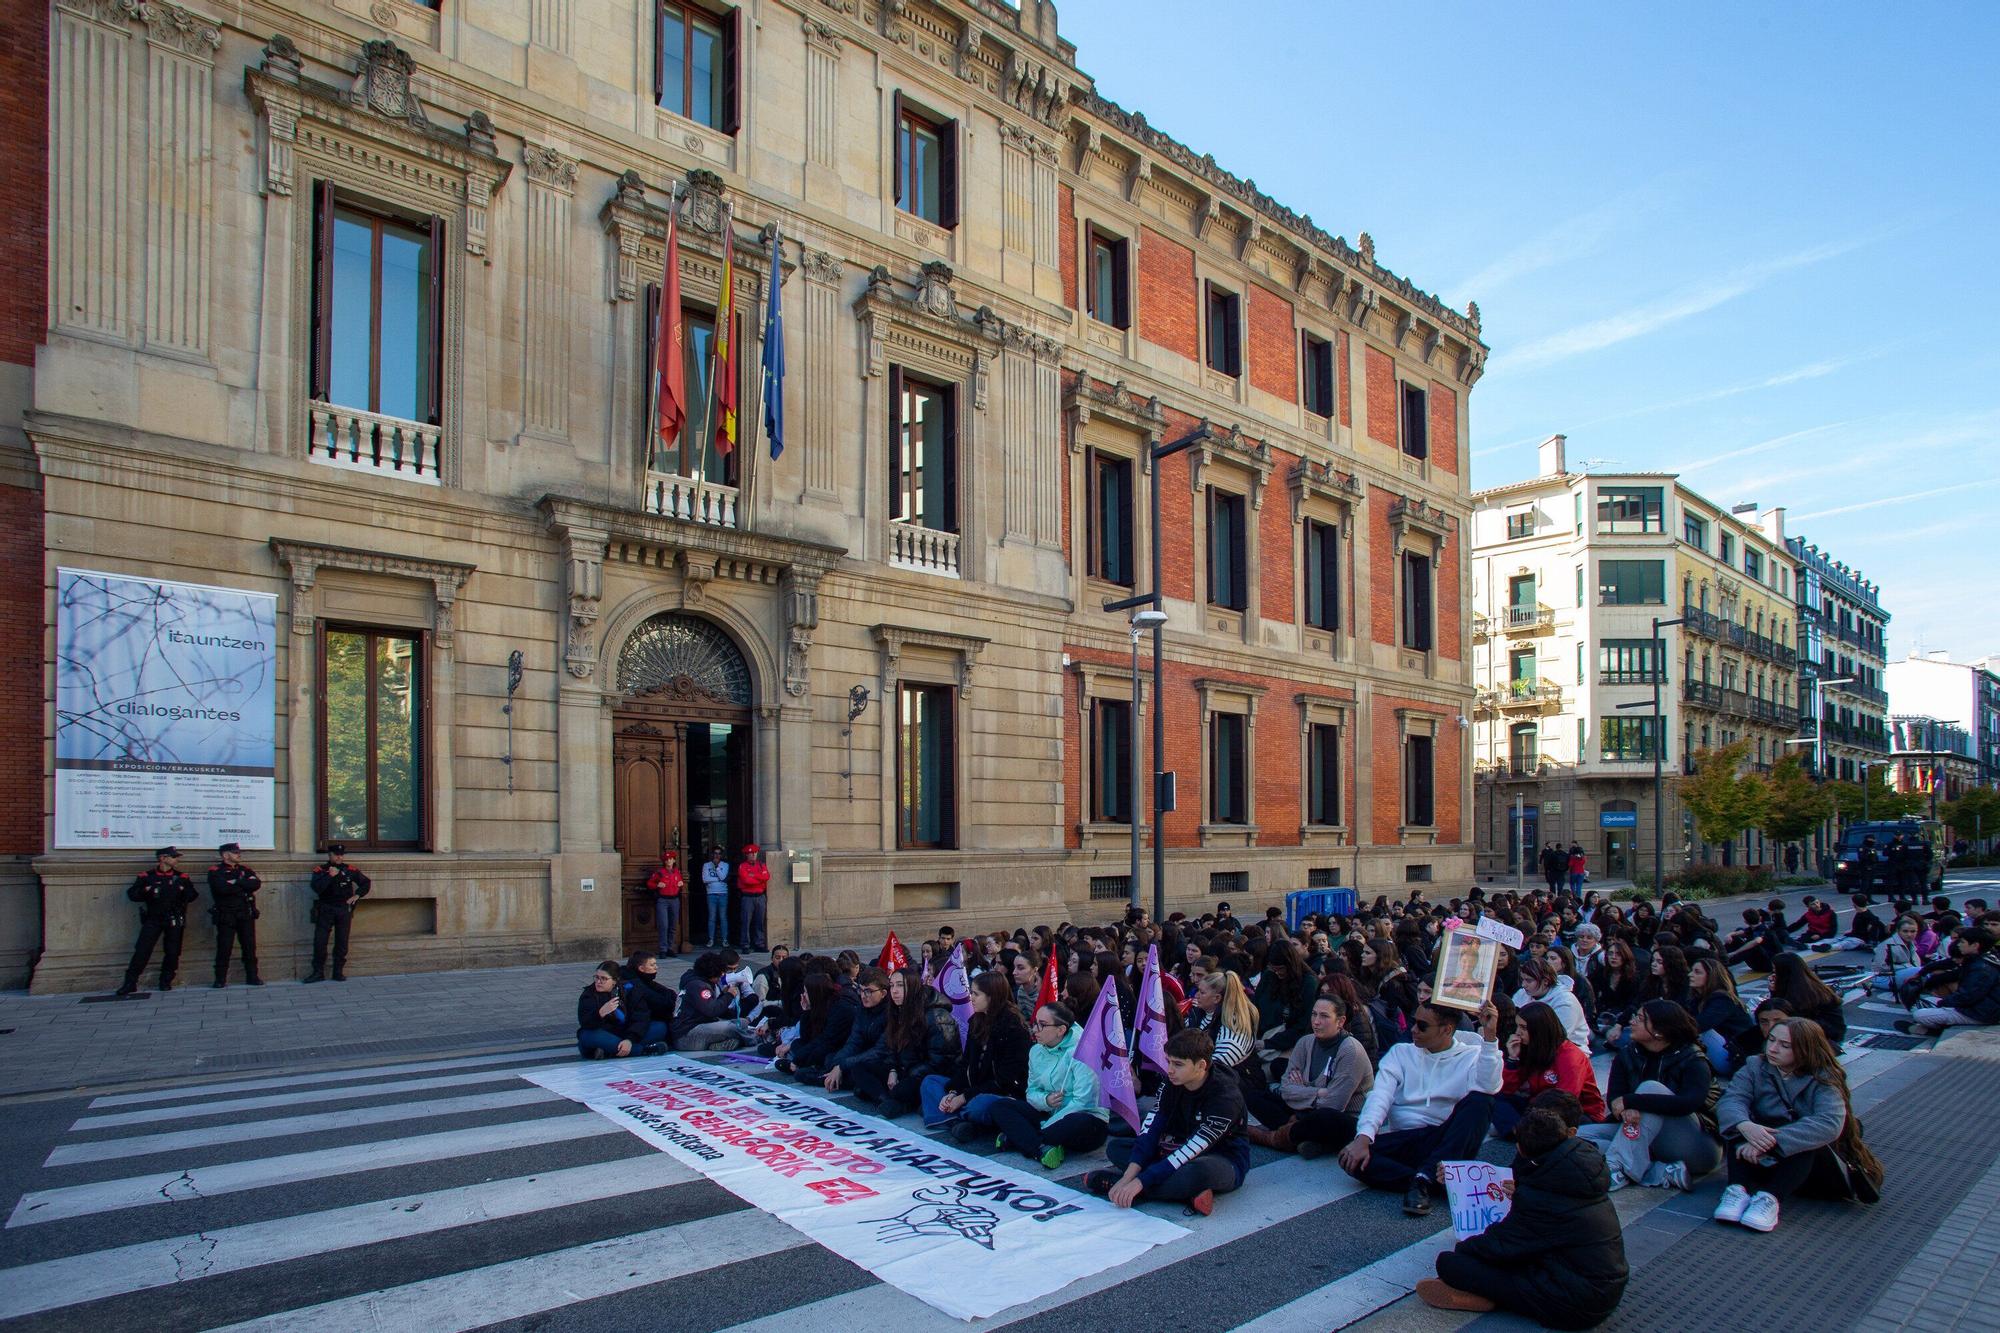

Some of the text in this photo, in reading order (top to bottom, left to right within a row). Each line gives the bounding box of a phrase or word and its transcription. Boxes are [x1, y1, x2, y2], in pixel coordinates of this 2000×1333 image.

[168, 629, 265, 651] itauntzen
[117, 701, 240, 721] dialogantes
[653, 1120, 725, 1161] Sindikatua
[679, 1110, 825, 1178] GEHIAGORIK
[804, 1176, 881, 1206] EZ!
[719, 1105, 770, 1125] ETA
[756, 1121, 887, 1174] GORROTO
[728, 1084, 775, 1097] EZ
[755, 1093, 877, 1137] ZAITUGU
[854, 1137, 1085, 1222] AHAZTUKO!
[1444, 1164, 1496, 1183] STOP
